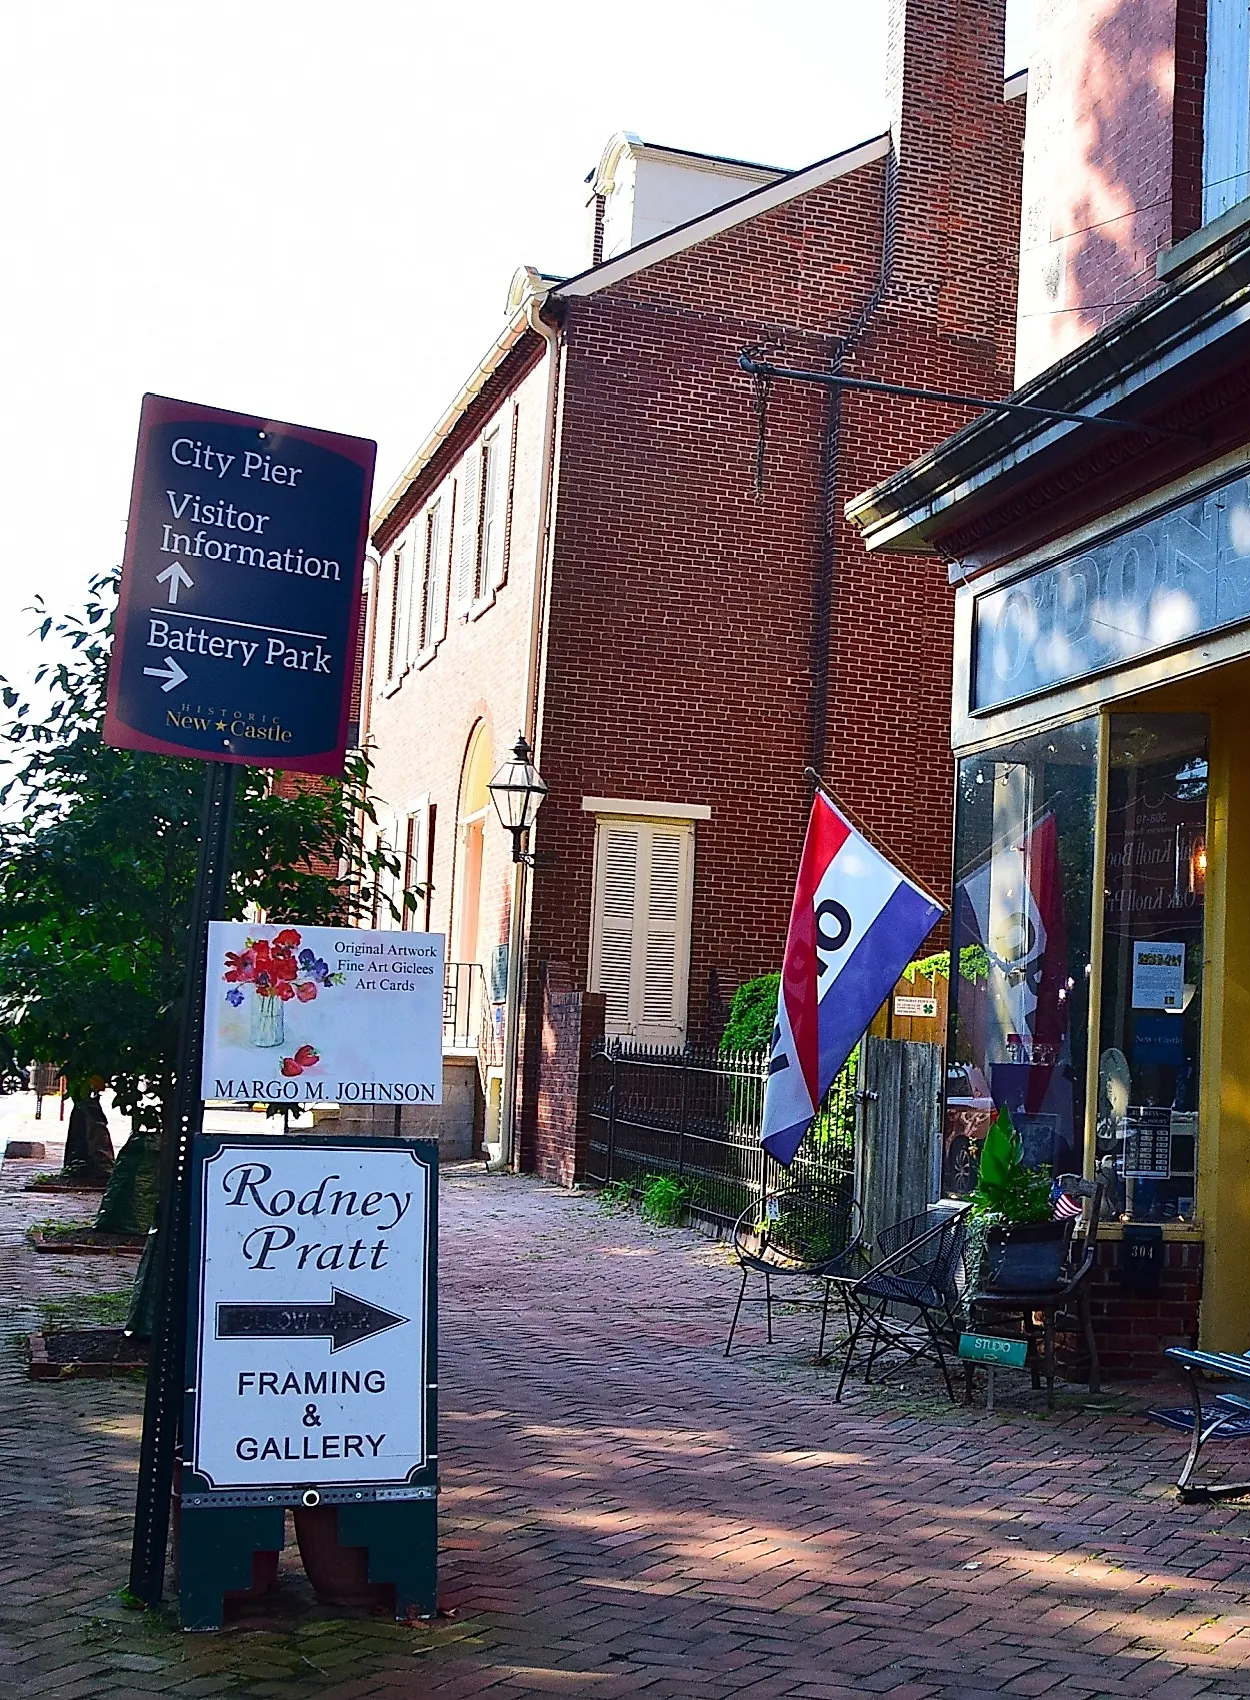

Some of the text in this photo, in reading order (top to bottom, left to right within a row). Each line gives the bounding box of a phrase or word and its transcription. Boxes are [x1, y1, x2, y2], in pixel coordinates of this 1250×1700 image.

[171, 438, 303, 487] City Pier
[166, 490, 270, 534] Visitor
[160, 524, 342, 581] Information
[146, 619, 332, 674] Battery Park
[165, 710, 293, 744] New Castle
[180, 703, 281, 725] HISTORIC
[334, 941, 437, 957] Original Artwork
[337, 959, 434, 975] Fine Art Giclees
[355, 977, 415, 992] Art Cards
[214, 1079, 436, 1101] MARGO M. JOHNSON
[222, 1162, 412, 1231] Rodney
[242, 1225, 389, 1271] Pratt
[1131, 1245, 1153, 1259] 304
[974, 1338, 1011, 1353] STUDIO
[237, 1370, 386, 1396] FRAMING
[302, 1403, 322, 1427] &
[236, 1433, 387, 1461] GALLERY
